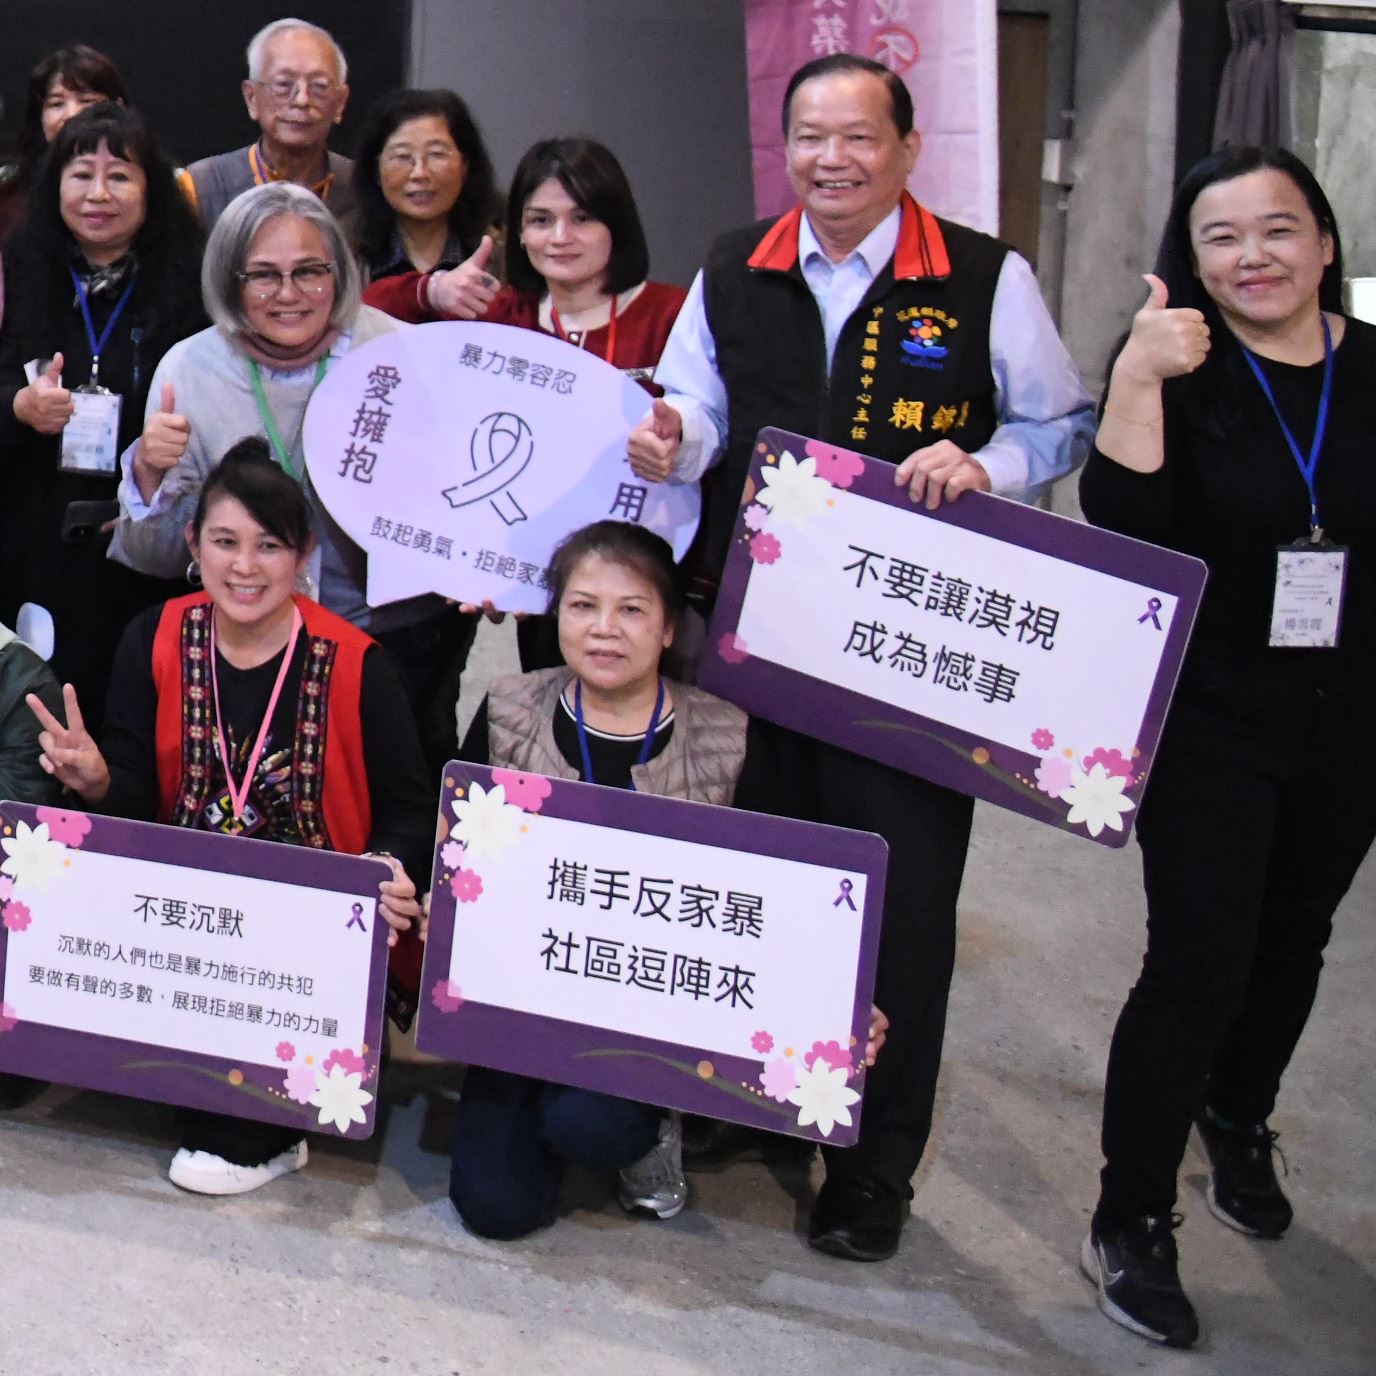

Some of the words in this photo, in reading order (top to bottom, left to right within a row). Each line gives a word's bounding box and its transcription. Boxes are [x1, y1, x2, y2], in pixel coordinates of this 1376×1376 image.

[458, 341, 577, 396] 暴力零容忍
[337, 365, 403, 485] 愛擁抱
[843, 544, 1060, 651] 不要讓漠視
[843, 621, 1021, 705] 成為憾事
[133, 893, 244, 938] 不要沉默
[546, 856, 765, 939] 攜手反家暴
[57, 934, 314, 997] 沉默的人們也是暴力施行的共犯
[539, 927, 755, 1010] 社區逗陣來
